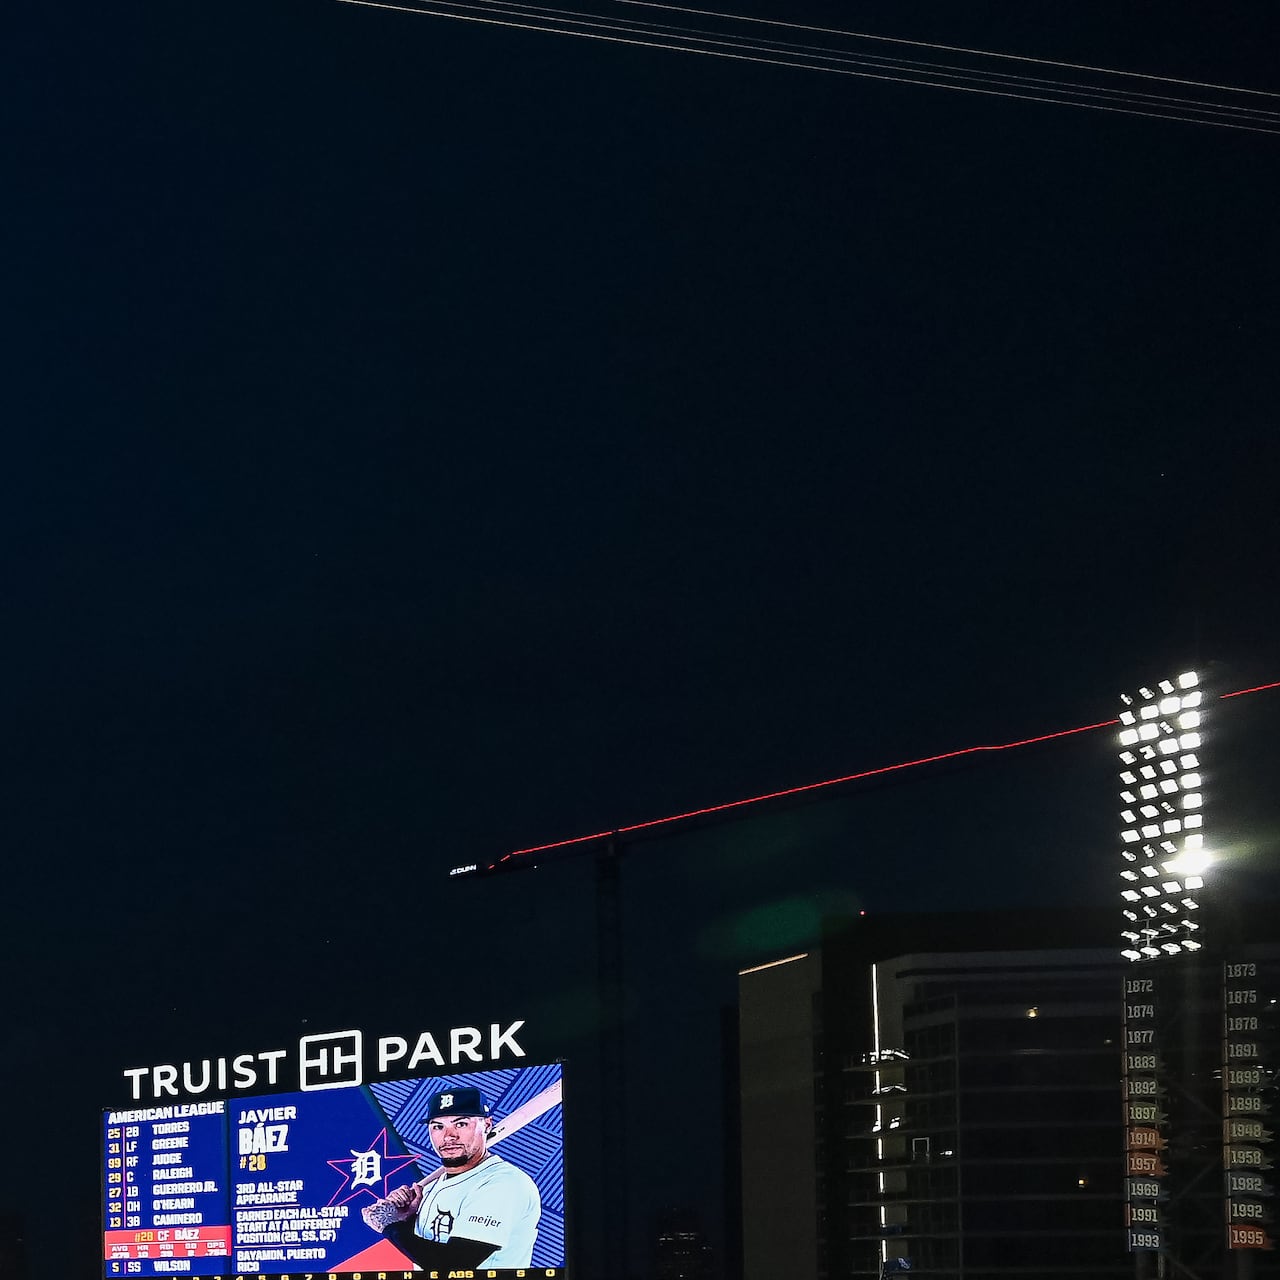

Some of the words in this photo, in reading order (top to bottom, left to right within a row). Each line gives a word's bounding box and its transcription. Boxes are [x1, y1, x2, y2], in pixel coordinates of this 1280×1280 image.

[1227, 963, 1256, 977] 1873
[1127, 980, 1153, 993] 1872
[1228, 990, 1257, 1004] 1875
[1127, 1005, 1153, 1018] 1874
[1128, 1030, 1153, 1043] 1877
[1228, 1043, 1258, 1057] 1891
[123, 1050, 288, 1099] TRUIST
[378, 1020, 526, 1072] PARK
[1229, 1070, 1259, 1084] 1893
[1129, 1081, 1156, 1093] 1892
[108, 1107, 173, 1124] AMERICAN
[174, 1101, 224, 1117] LEAGUE
[239, 1106, 297, 1124] JAVIER
[152, 1121, 189, 1135] TORRES
[152, 1137, 188, 1150] GREENE
[239, 1123, 289, 1155] BÁEZ
[152, 1153, 182, 1165] JUDGE
[1130, 1158, 1156, 1170] 1957
[1231, 1150, 1261, 1164] 1958
[152, 1167, 193, 1180] RALEIGH
[153, 1182, 203, 1195] GUERRERO
[204, 1181, 218, 1192] JR.
[236, 1183, 255, 1194] 3RD
[257, 1180, 303, 1192] ALL-STAR
[1131, 1184, 1158, 1196] 1969
[1231, 1177, 1262, 1191] 1982
[153, 1198, 194, 1210] O'HEARN
[236, 1192, 297, 1205] APPEARANCE
[236, 1210, 273, 1222] EARNED
[274, 1208, 300, 1220] EACH
[300, 1206, 348, 1218] ALL-STAR
[1131, 1209, 1158, 1222] 1991
[1231, 1204, 1263, 1218] 1992
[153, 1213, 202, 1225] CAMINERO
[237, 1221, 268, 1233] START
[268, 1220, 281, 1231] AT
[282, 1220, 289, 1230] A
[290, 1218, 342, 1230] DIFFERENT
[468, 1212, 502, 1229] meijer
[157, 1231, 169, 1240] CF
[174, 1228, 200, 1240] BÁEZ
[1131, 1234, 1159, 1248] 1993
[1232, 1230, 1263, 1244] 1995
[154, 1260, 190, 1272] WILSON
